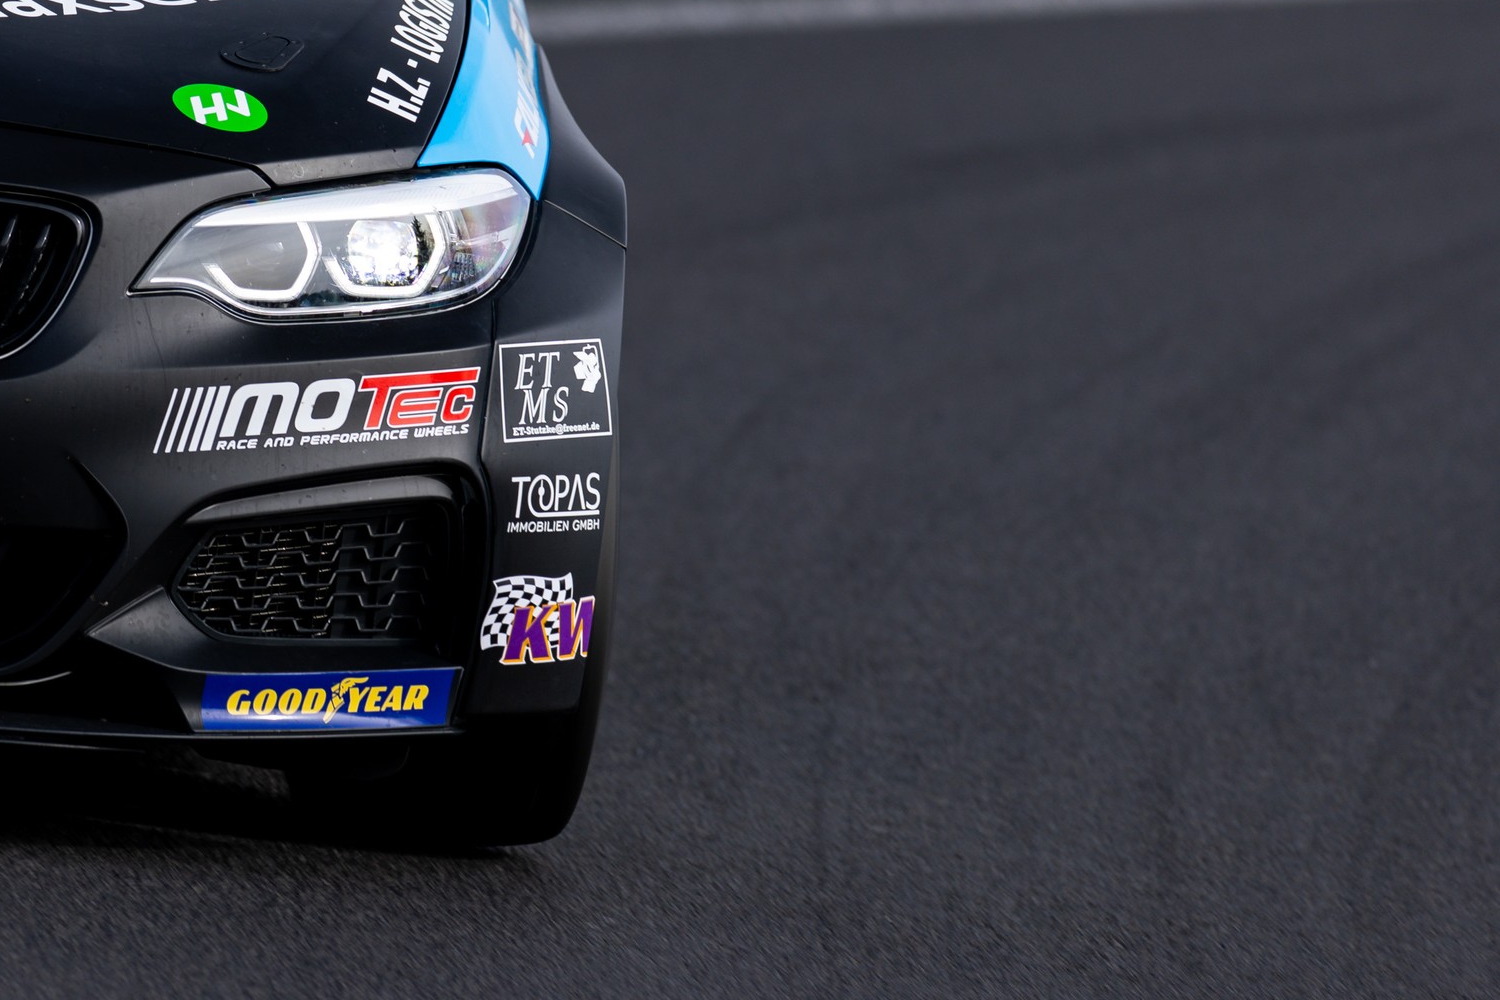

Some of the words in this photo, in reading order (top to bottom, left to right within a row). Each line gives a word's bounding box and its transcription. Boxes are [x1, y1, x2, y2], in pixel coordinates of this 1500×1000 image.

[515, 351, 561, 391] ET
[219, 366, 481, 436] MOTEC
[518, 387, 570, 426] MS
[216, 439, 258, 451] RACE
[263, 437, 294, 449] AND
[299, 429, 410, 447] PERFORMANCE
[413, 424, 470, 438] WHEELS
[512, 422, 601, 437] ET-Stutzke@freenet.de
[511, 472, 601, 518] TOPAS
[507, 520, 571, 534] IMMOBILIEN
[572, 518, 601, 532] GMBH
[499, 596, 596, 666] KW
